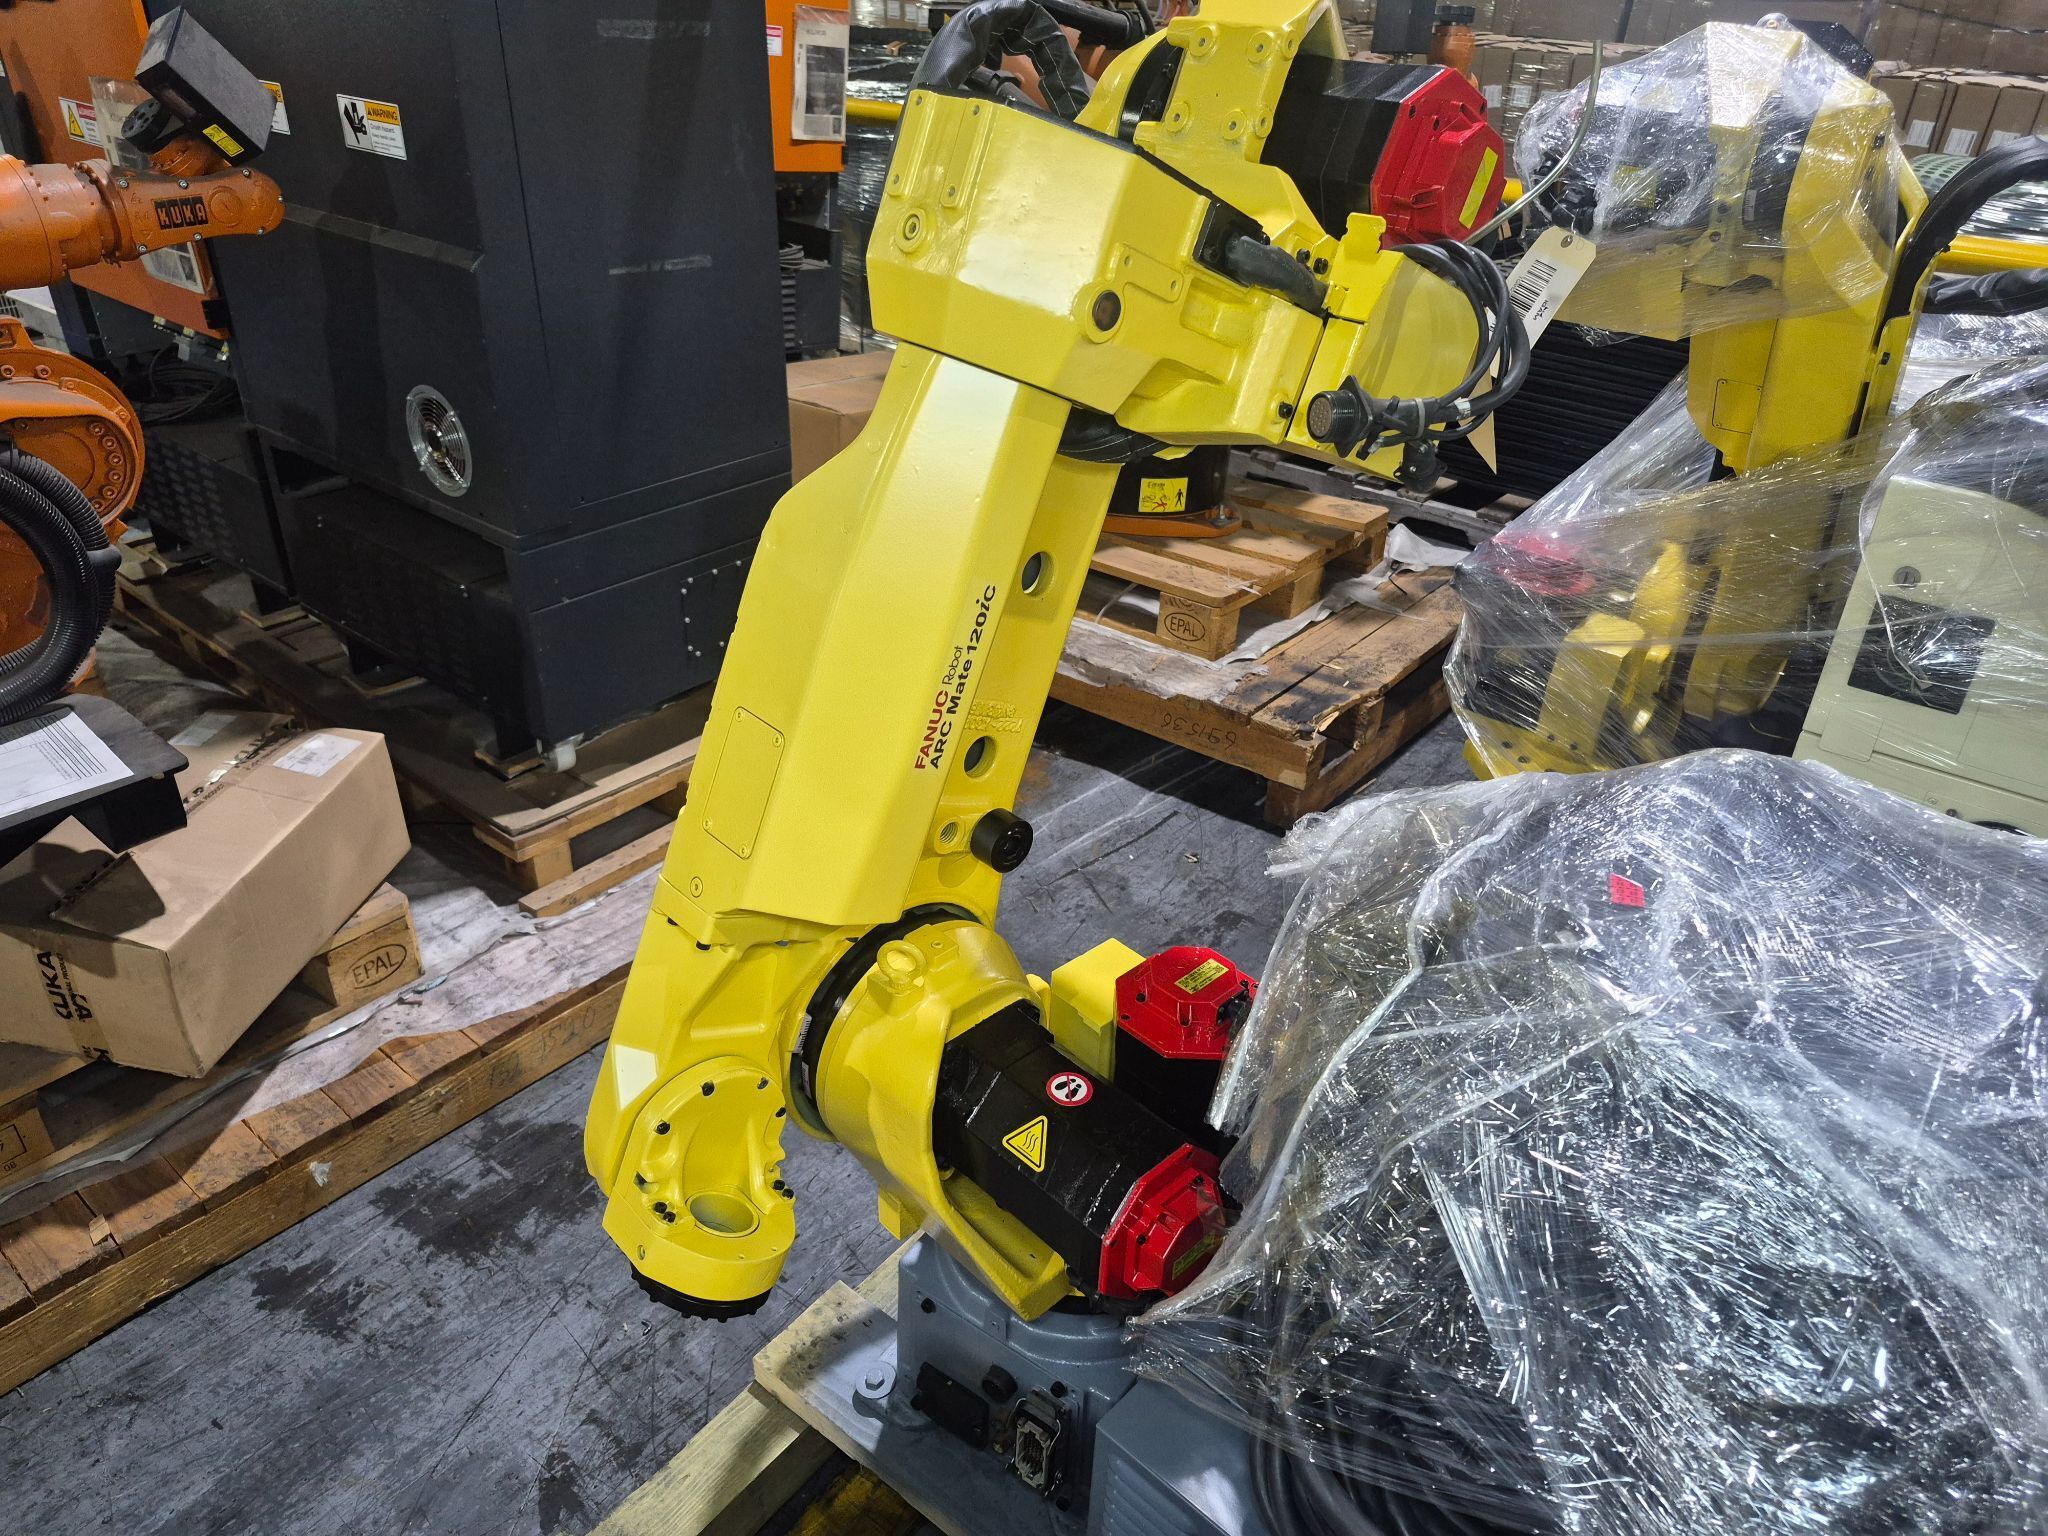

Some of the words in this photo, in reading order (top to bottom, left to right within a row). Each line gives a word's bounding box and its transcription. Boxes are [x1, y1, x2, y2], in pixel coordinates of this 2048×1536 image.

[157, 203, 206, 226] KUKA
[1170, 616, 1199, 638] EPAL
[930, 720, 952, 769] ARC
[946, 659, 972, 715] Mate
[967, 584, 996, 651] 120iC
[914, 690, 949, 769] FANUC
[942, 645, 963, 685] Robot
[352, 951, 400, 984] EPAL
